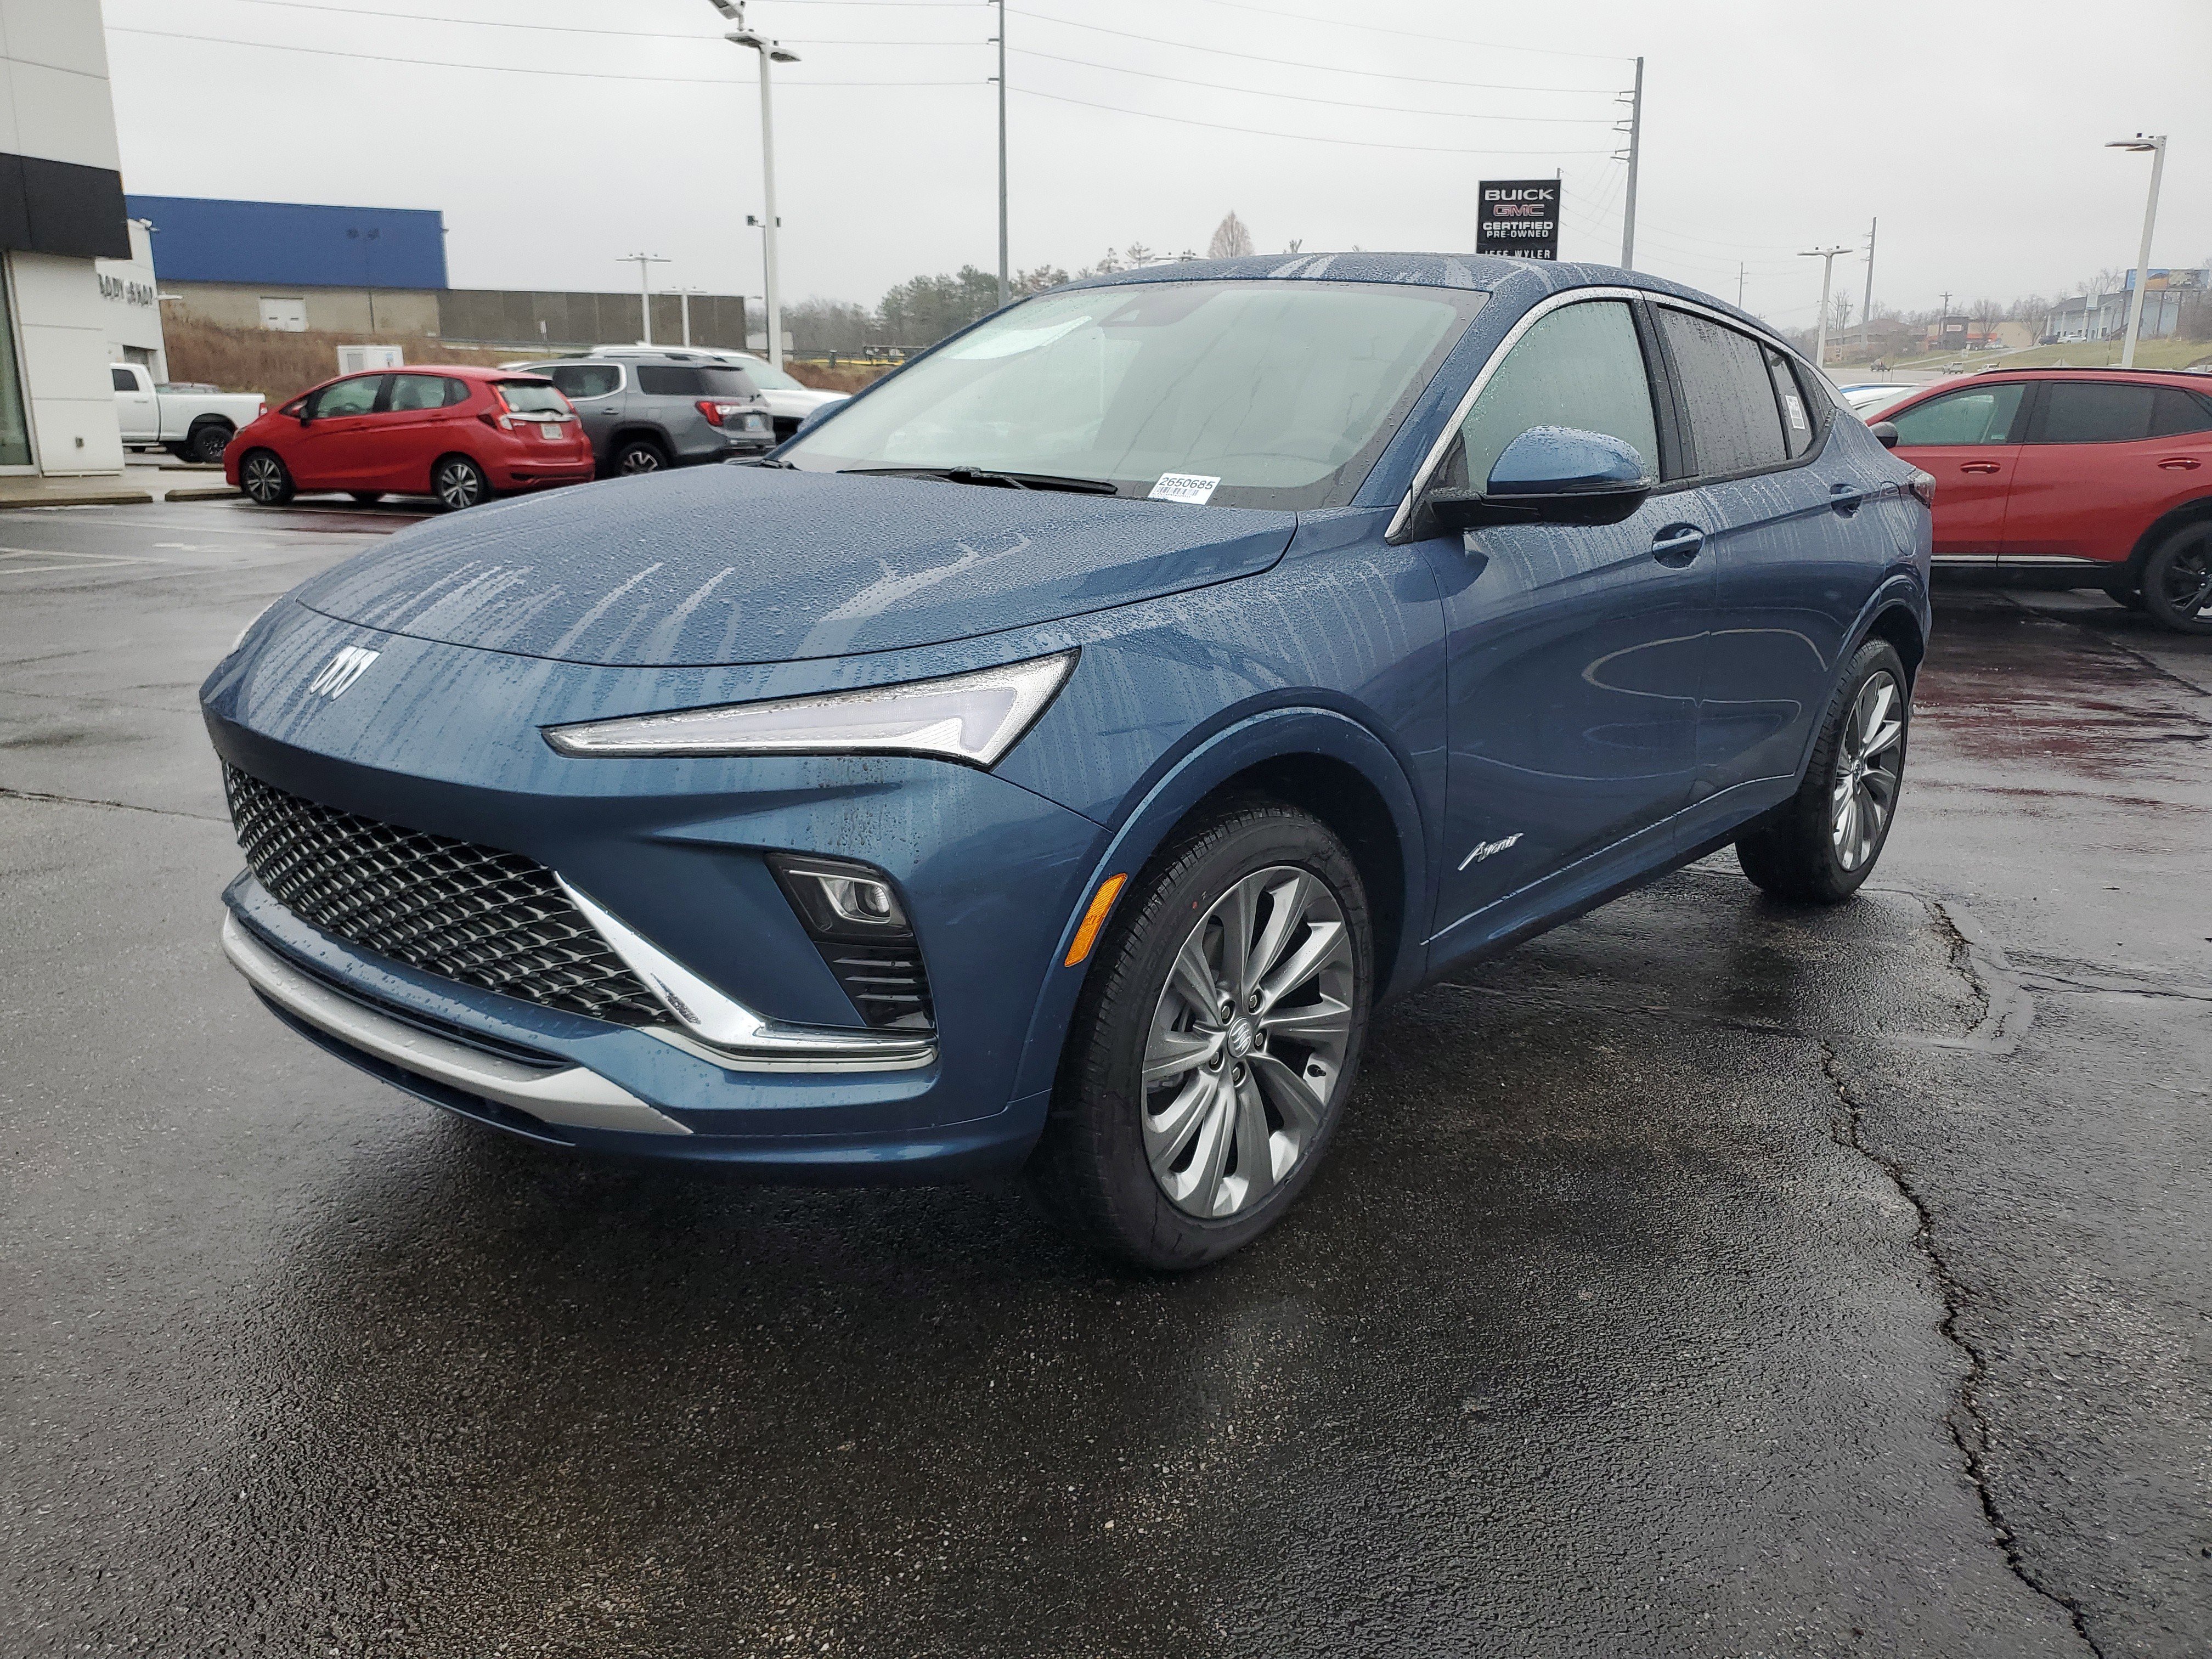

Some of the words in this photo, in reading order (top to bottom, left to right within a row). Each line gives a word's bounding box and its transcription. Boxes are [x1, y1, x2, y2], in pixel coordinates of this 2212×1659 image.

[1485, 189, 1554, 201] BUICK
[1493, 204, 1544, 217] GMC
[1483, 221, 1554, 230] CERTIFIED
[1486, 230, 1549, 238] PRE-OWNED
[1515, 249, 1550, 258] WYLER
[1159, 477, 1216, 490] 2650685
